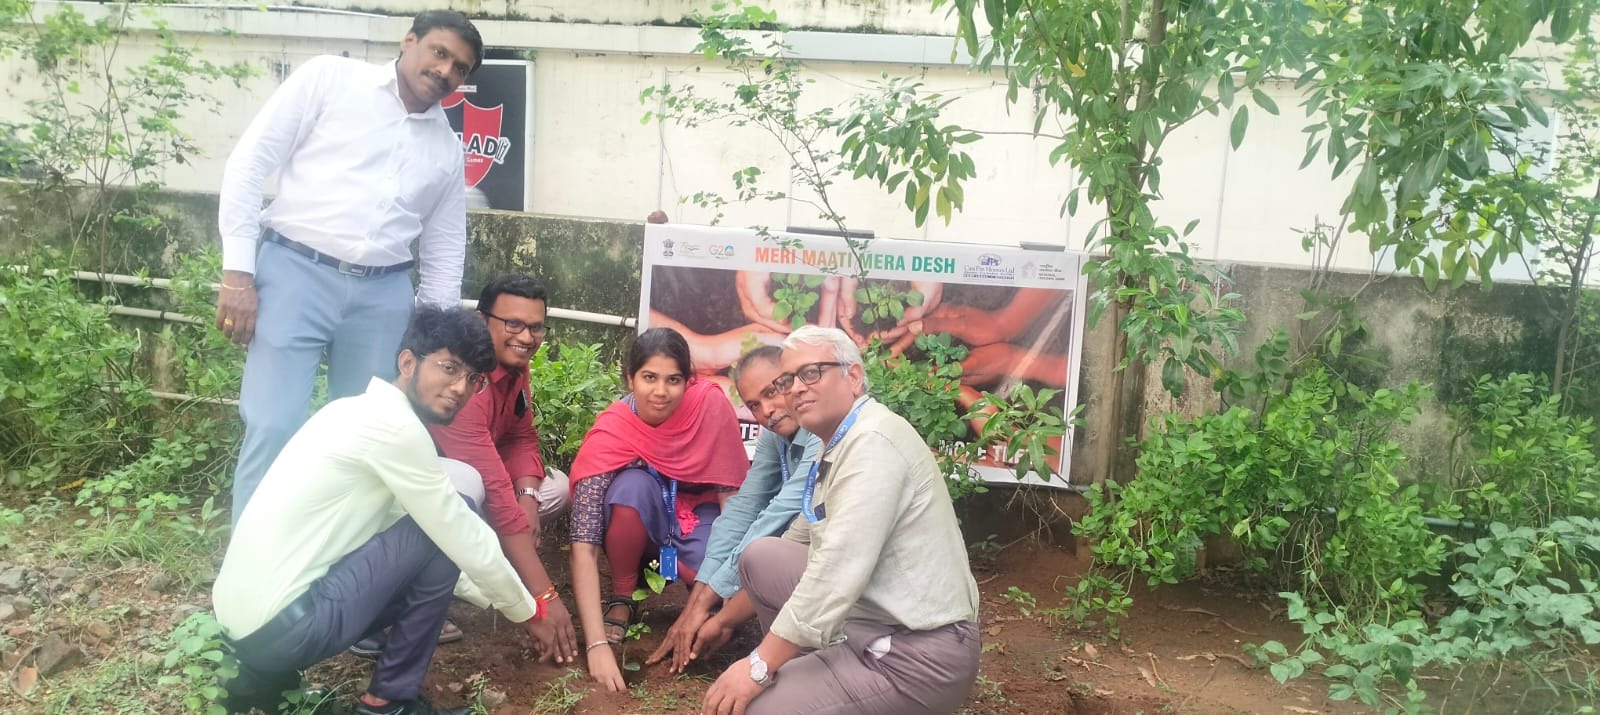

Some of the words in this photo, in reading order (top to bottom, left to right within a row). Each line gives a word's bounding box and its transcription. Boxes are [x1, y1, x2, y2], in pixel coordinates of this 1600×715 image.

[755, 246, 797, 265] MERI
[801, 249, 852, 268] MAATI
[859, 253, 905, 271] MERA
[911, 255, 956, 274] DESH
[939, 439, 987, 460] MOE
